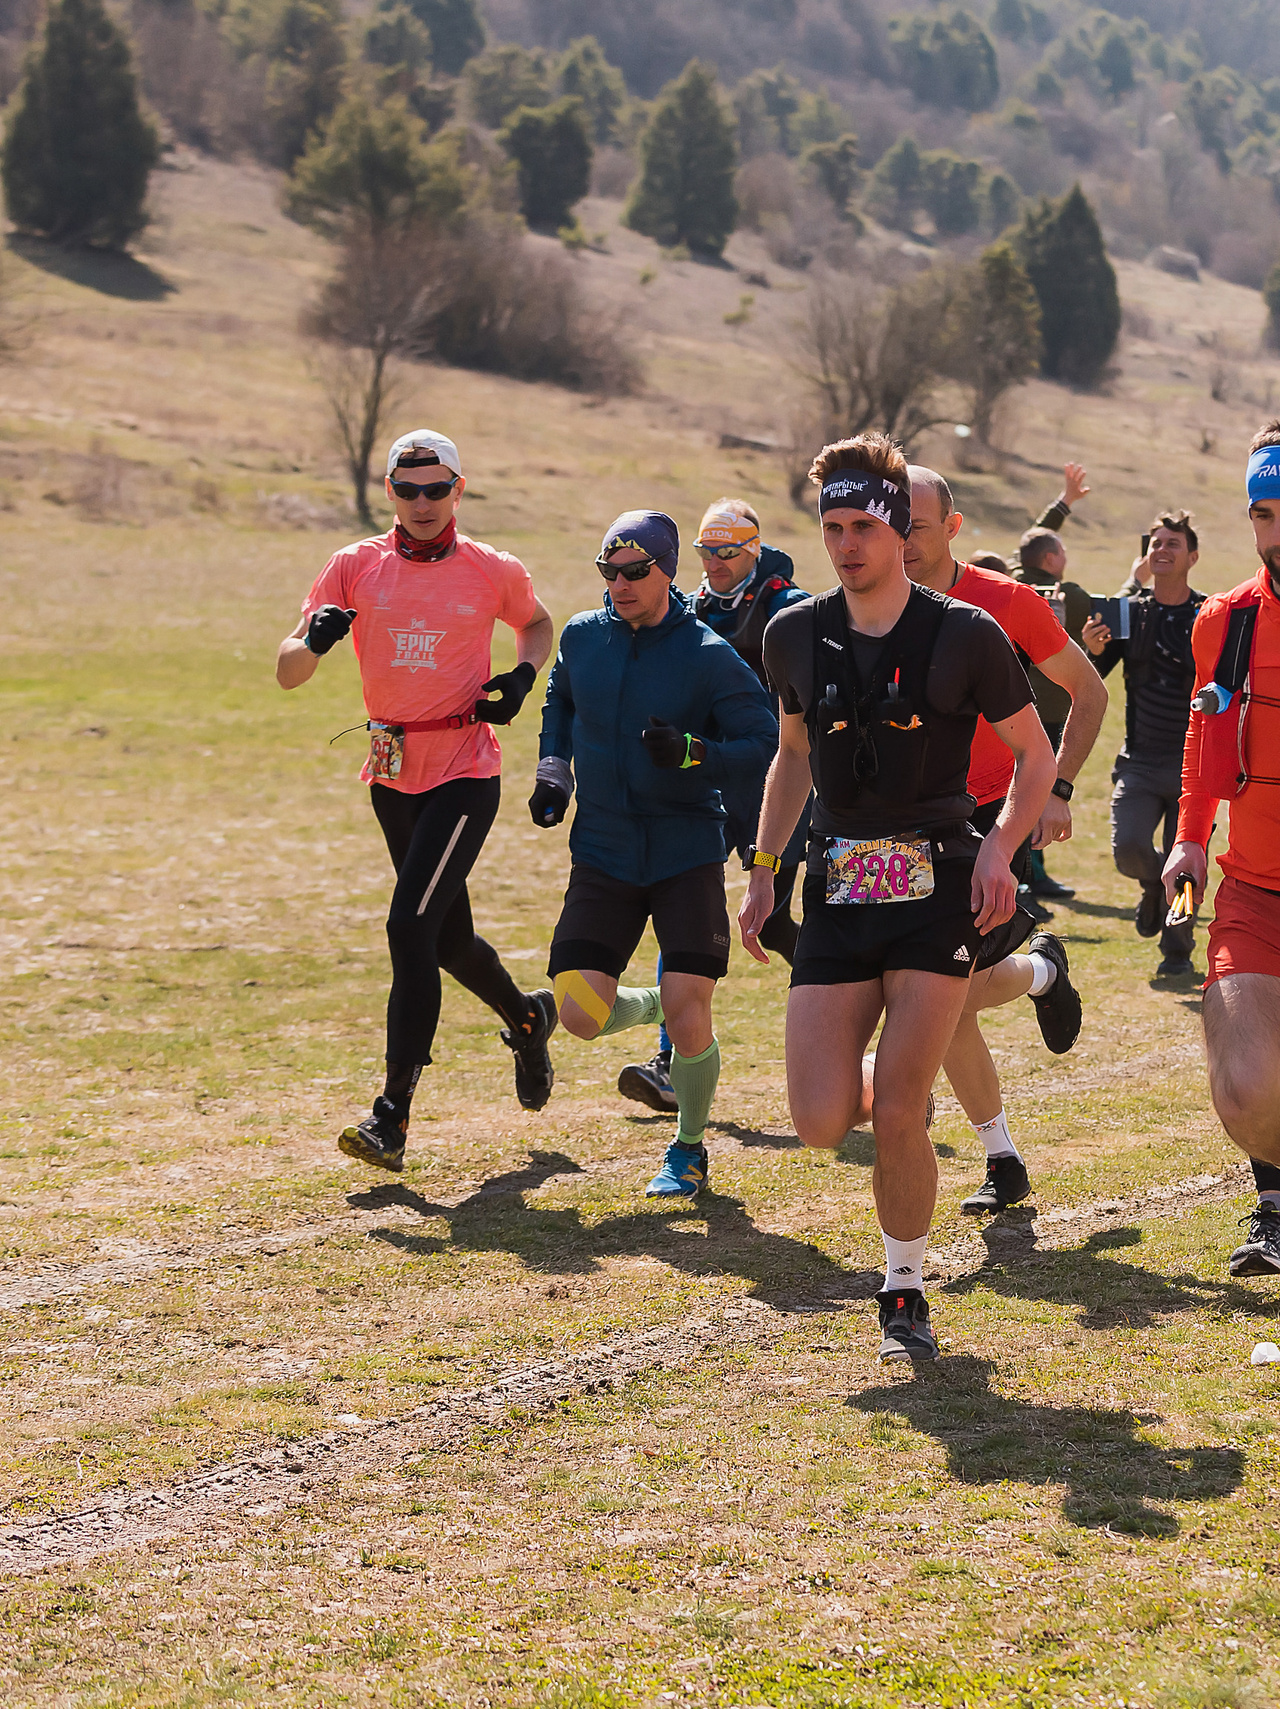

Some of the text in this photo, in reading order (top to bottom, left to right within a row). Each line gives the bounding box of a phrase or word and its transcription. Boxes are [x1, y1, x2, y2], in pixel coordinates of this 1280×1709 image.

[396, 633, 437, 652] EPIC
[395, 651, 435, 660] TRAIL
[840, 840, 850, 849] KM
[895, 842, 921, 861] TRAIL
[848, 854, 909, 898] 228
